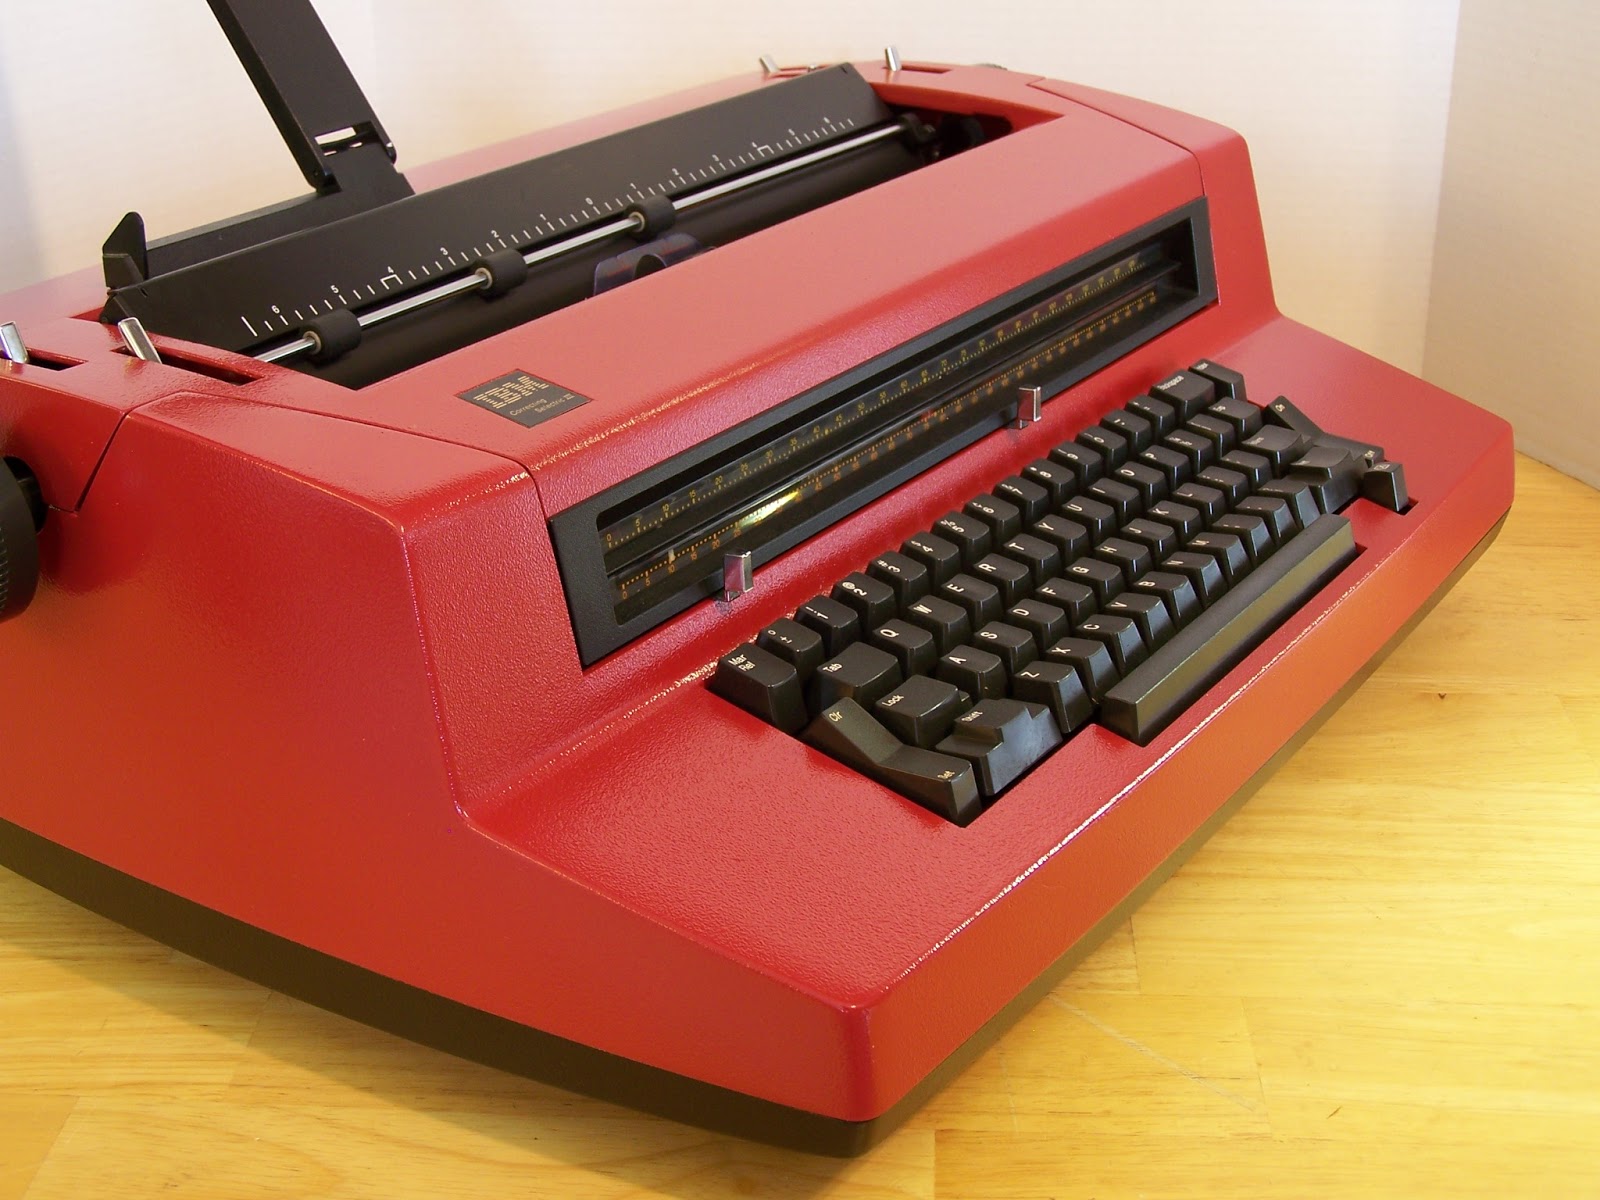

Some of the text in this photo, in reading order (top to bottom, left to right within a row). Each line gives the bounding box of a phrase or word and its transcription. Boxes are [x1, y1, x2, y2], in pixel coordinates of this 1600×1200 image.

[271, 305, 280, 314] 6
[330, 285, 339, 294] 5
[387, 266, 394, 274] 4
[440, 247, 448, 256] 3
[491, 230, 500, 238] 2
[585, 198, 594, 206] 0
[472, 376, 550, 408] IBM
[510, 398, 548, 416] Correcting
[534, 398, 566, 413] Selectric
[1040, 470, 1052, 478] 8
[1012, 486, 1022, 495] 7
[1067, 504, 1082, 512] U
[606, 533, 612, 541] 0
[635, 518, 640, 526] 5
[662, 503, 670, 512] 10
[689, 489, 697, 498] 15
[940, 518, 956, 527] %
[1038, 522, 1054, 530] Y
[952, 524, 965, 532] 5
[1008, 542, 1024, 550] T
[1100, 546, 1118, 554] H
[888, 564, 900, 573] 3
[978, 563, 996, 572] R
[622, 591, 628, 599] 0
[645, 578, 651, 586] 5
[668, 564, 676, 574] 10
[842, 582, 856, 590] @
[853, 588, 868, 596] 2
[946, 583, 964, 592] E
[1042, 586, 1056, 595] F
[913, 604, 932, 614] W
[1012, 608, 1030, 616] D
[816, 612, 828, 620] 1
[880, 628, 900, 638] Q
[980, 632, 998, 640] S
[728, 654, 748, 666] Mar
[948, 656, 967, 664] A
[738, 661, 756, 672] Rel
[822, 663, 842, 672] Tab
[882, 694, 904, 706] Lock
[828, 711, 842, 722] Clr
